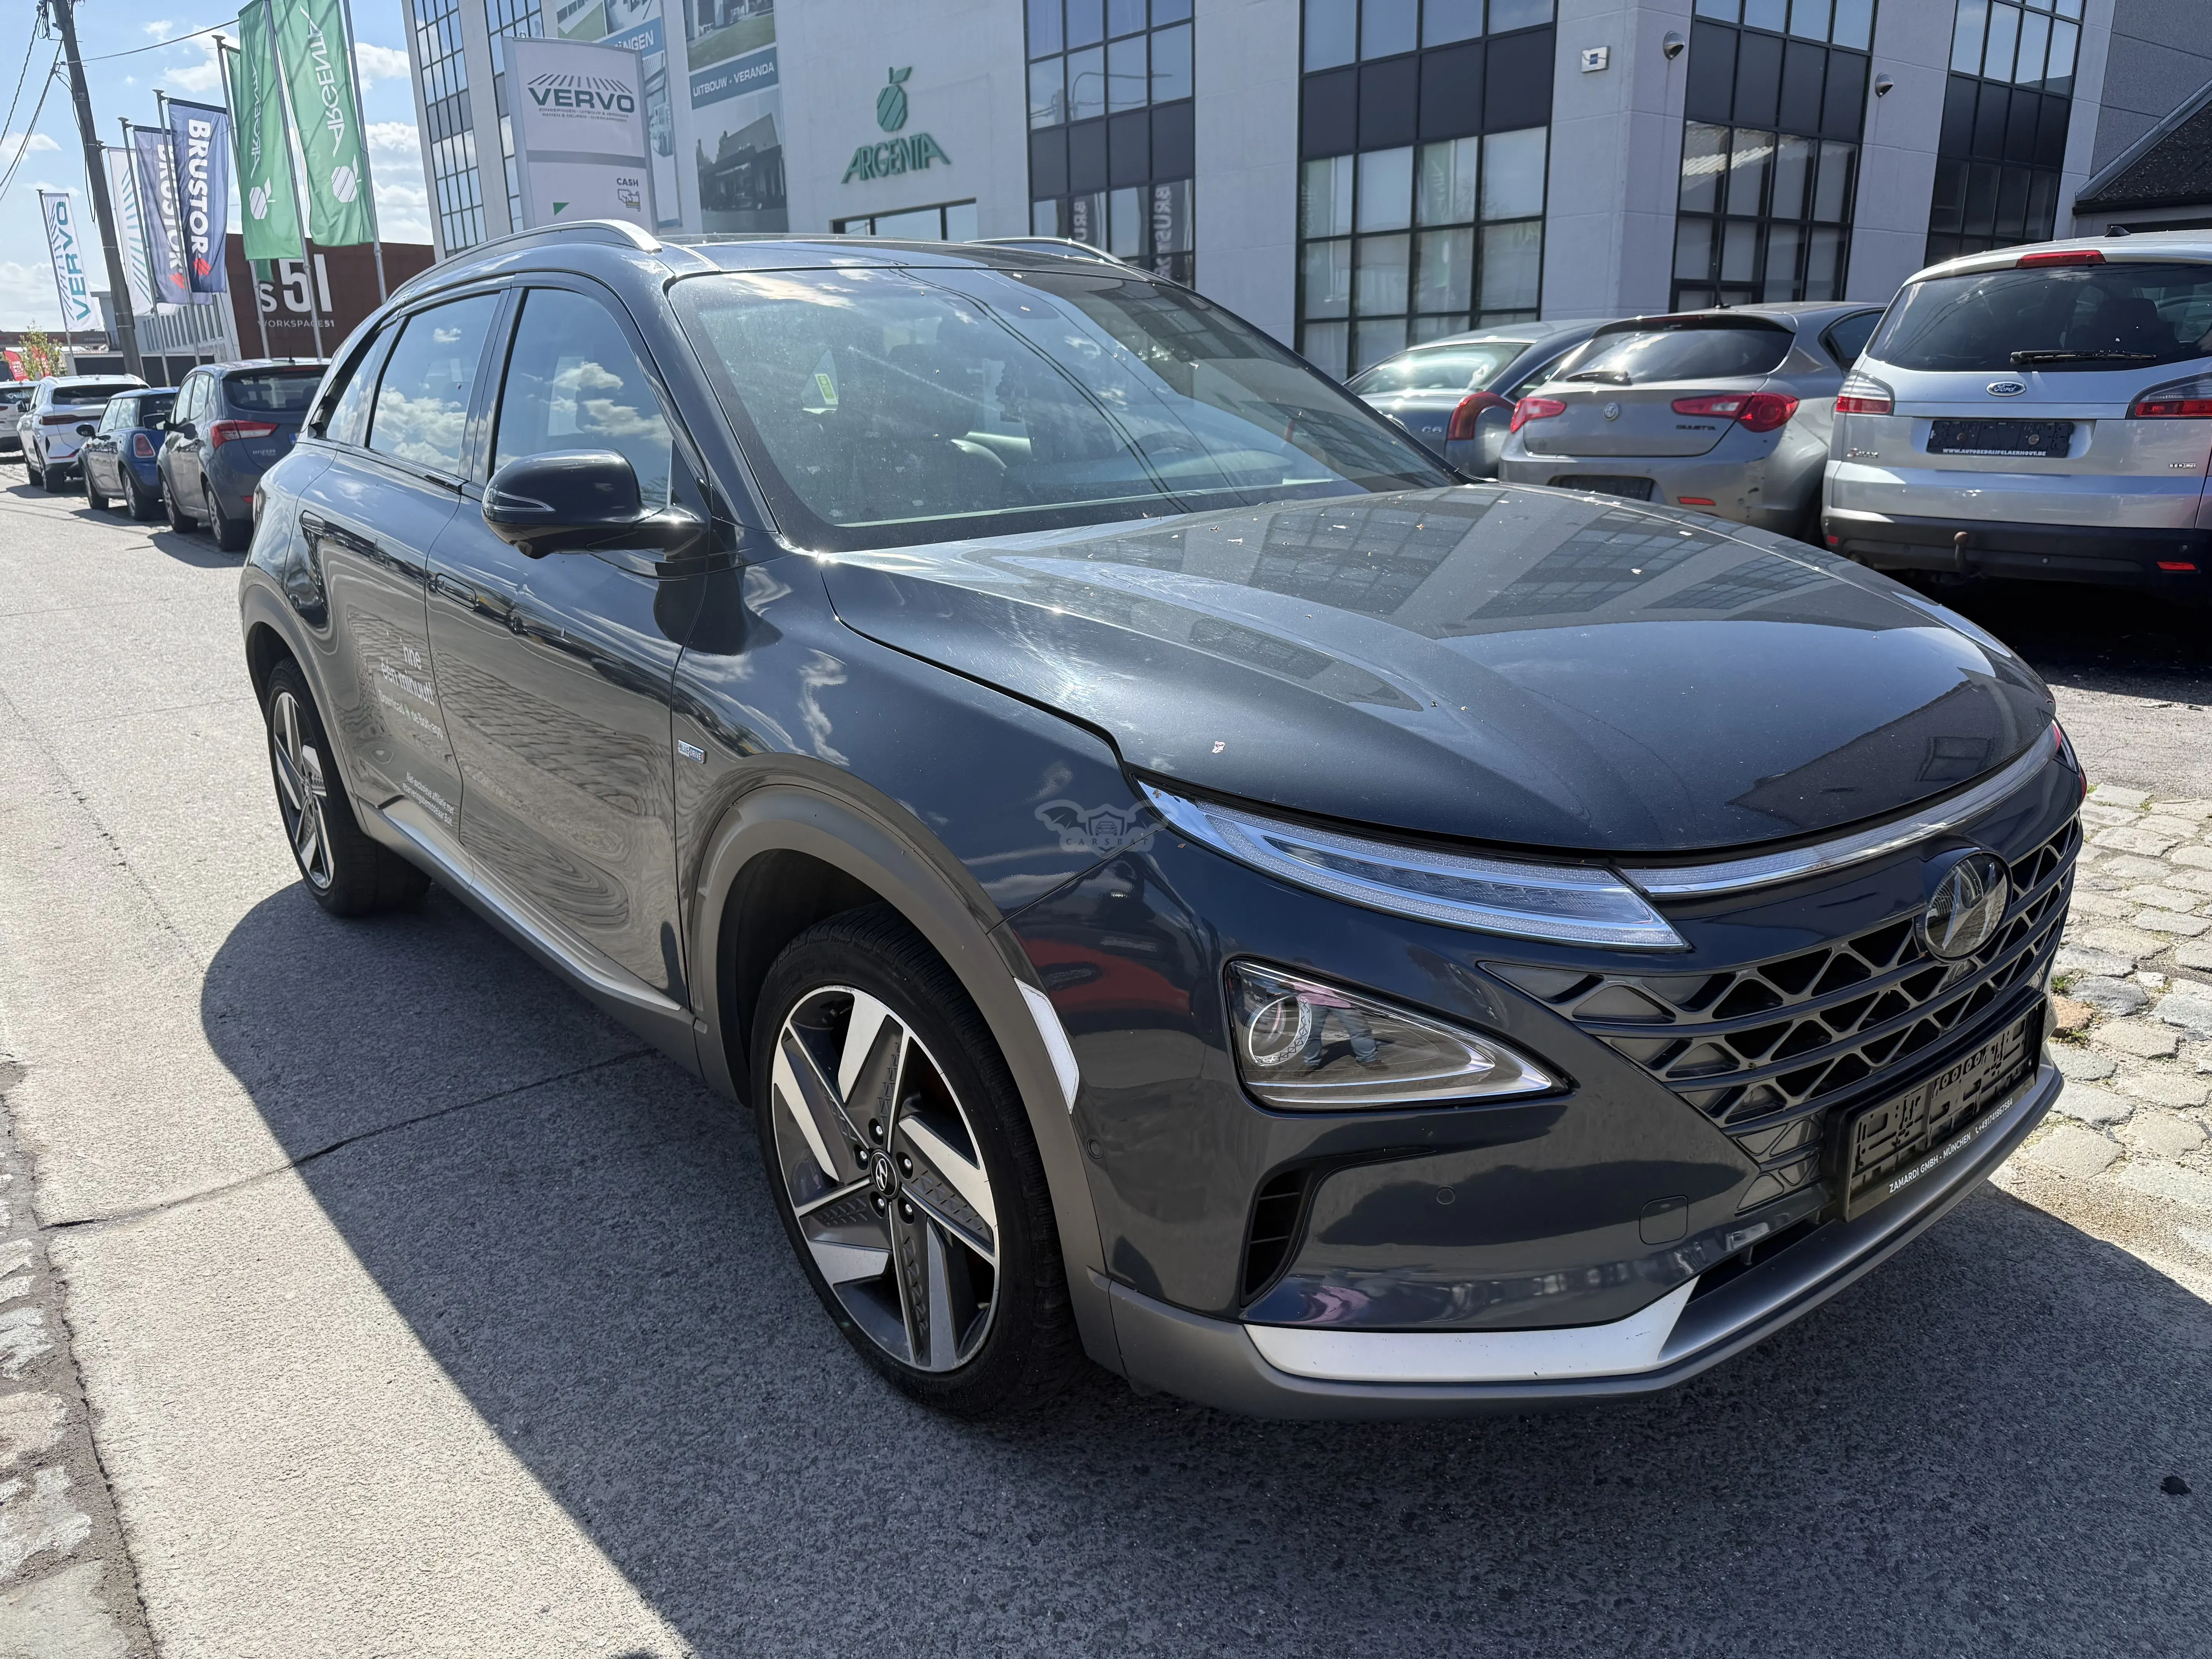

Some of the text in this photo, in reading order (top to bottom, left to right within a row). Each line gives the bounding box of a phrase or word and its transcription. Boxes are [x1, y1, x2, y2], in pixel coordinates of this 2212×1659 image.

[528, 88, 635, 113] VERVO
[693, 76, 727, 97] UITBOUW
[733, 62, 775, 83] VERANDA
[617, 178, 639, 187] CASH
[841, 133, 951, 184] ARGENTA
[188, 119, 211, 254] BRUSTOR
[57, 201, 91, 321] VERVO
[1994, 384, 2016, 392] Ford
[381, 657, 435, 706] één minuut!
[378, 689, 443, 740] Download de Bolt-app
[1889, 1167, 1919, 1194] ZAMARDI
[1920, 1155, 1938, 1173] GMBH
[1943, 1132, 1971, 1159] MÜNCHEN
